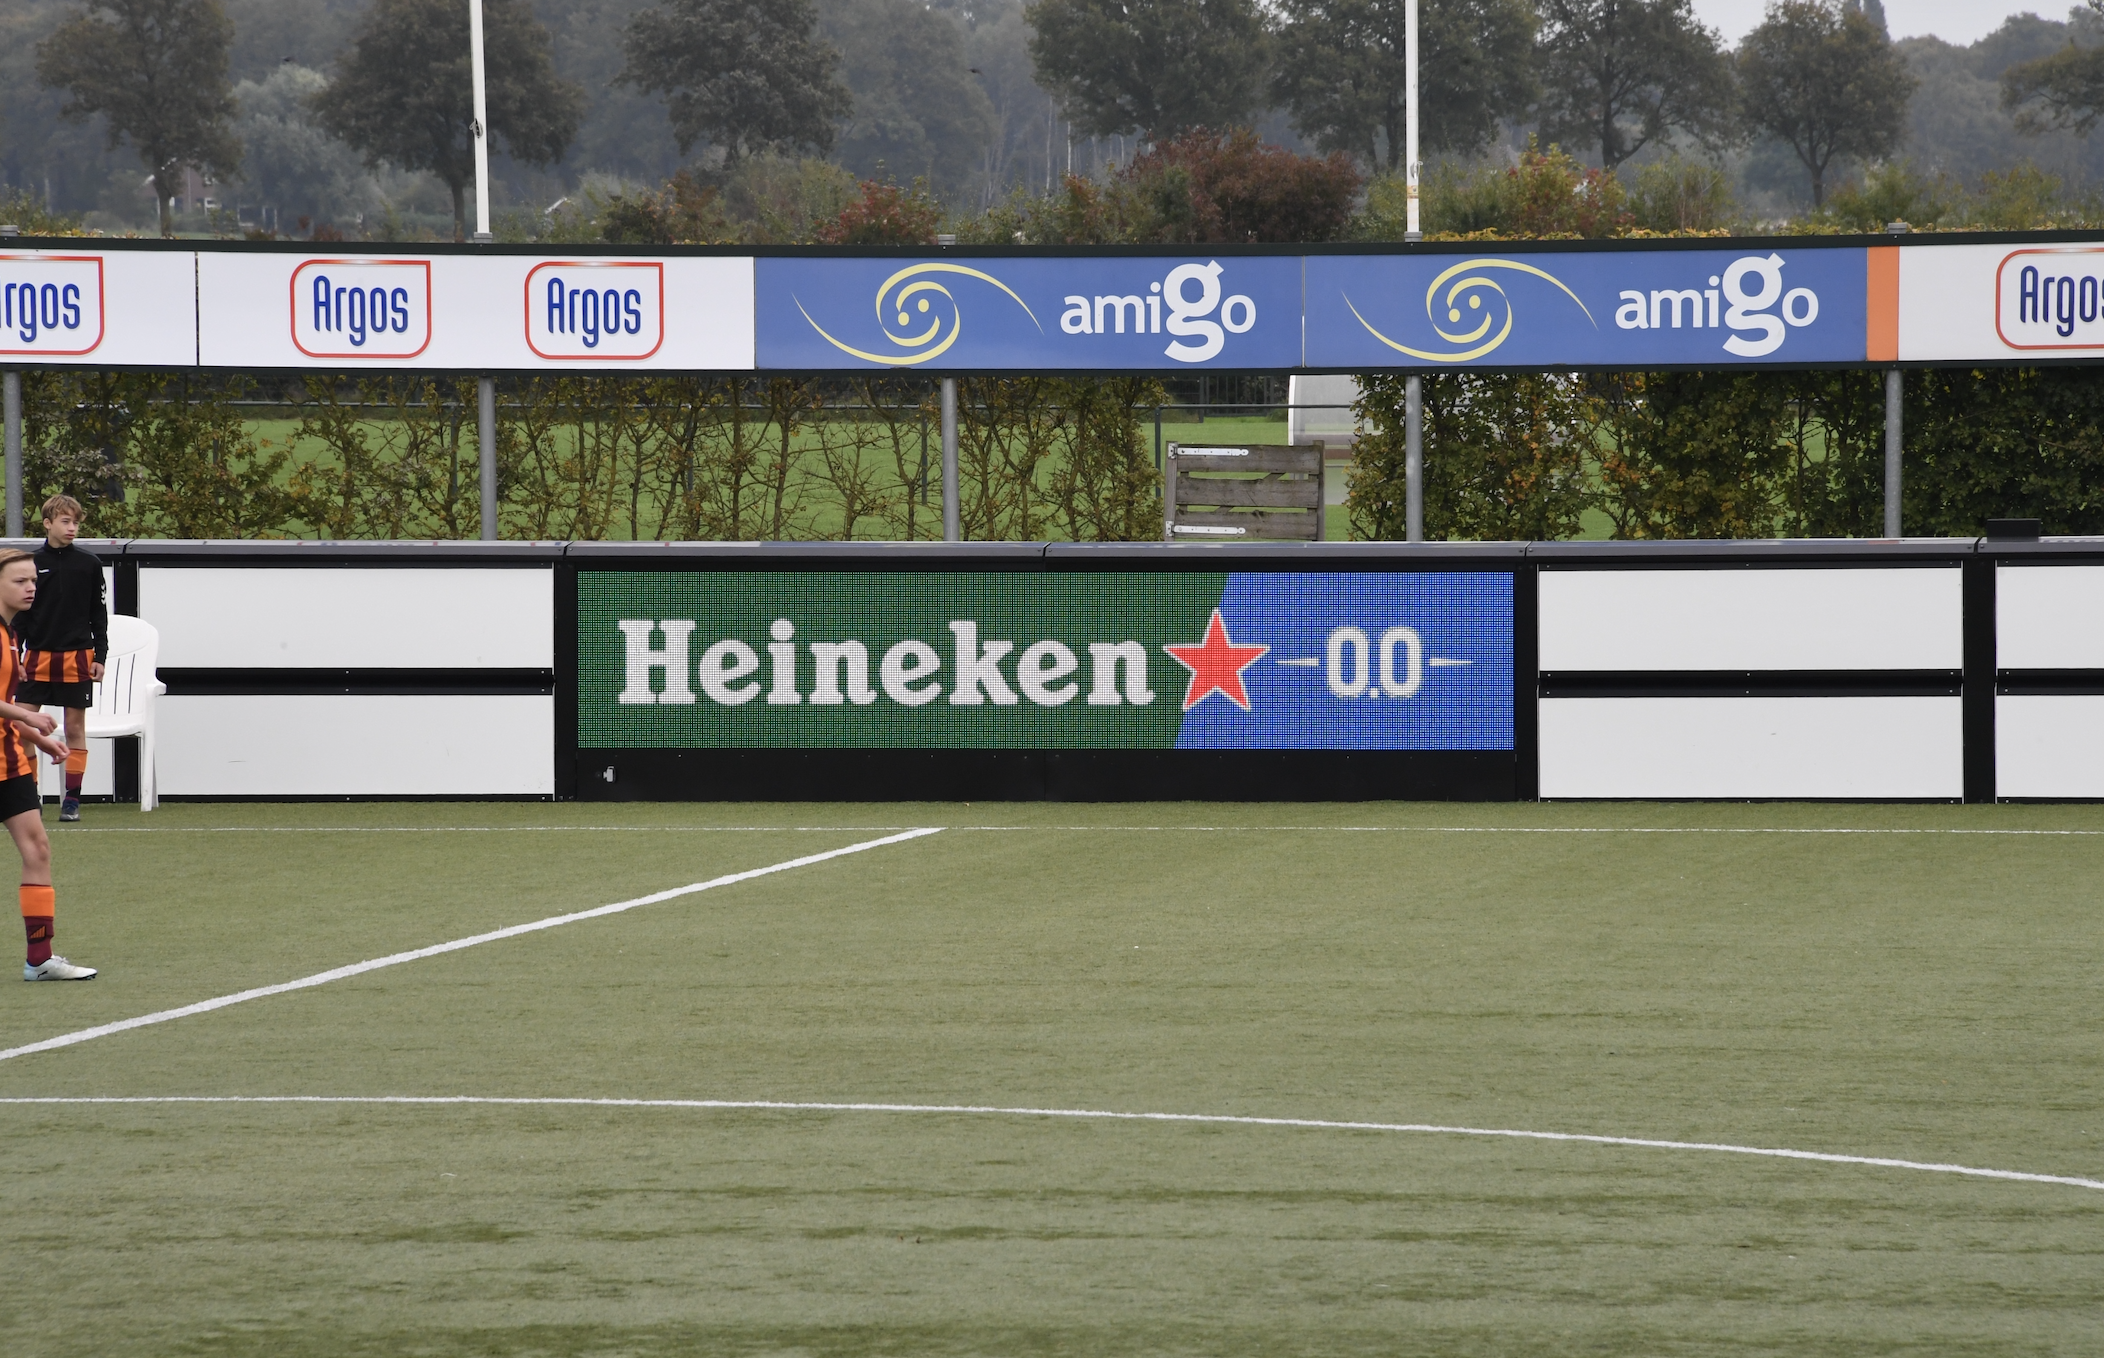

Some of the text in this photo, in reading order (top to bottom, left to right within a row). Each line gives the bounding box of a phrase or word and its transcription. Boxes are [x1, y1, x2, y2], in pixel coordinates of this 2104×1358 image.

[0, 282, 81, 343] rgos
[313, 275, 409, 347] Argos
[547, 277, 641, 348] Argos
[1060, 259, 1257, 363] amigo
[1615, 252, 1819, 358] amigo
[2020, 265, 2104, 337] Argo
[617, 619, 1422, 707] Heineken 0.0
